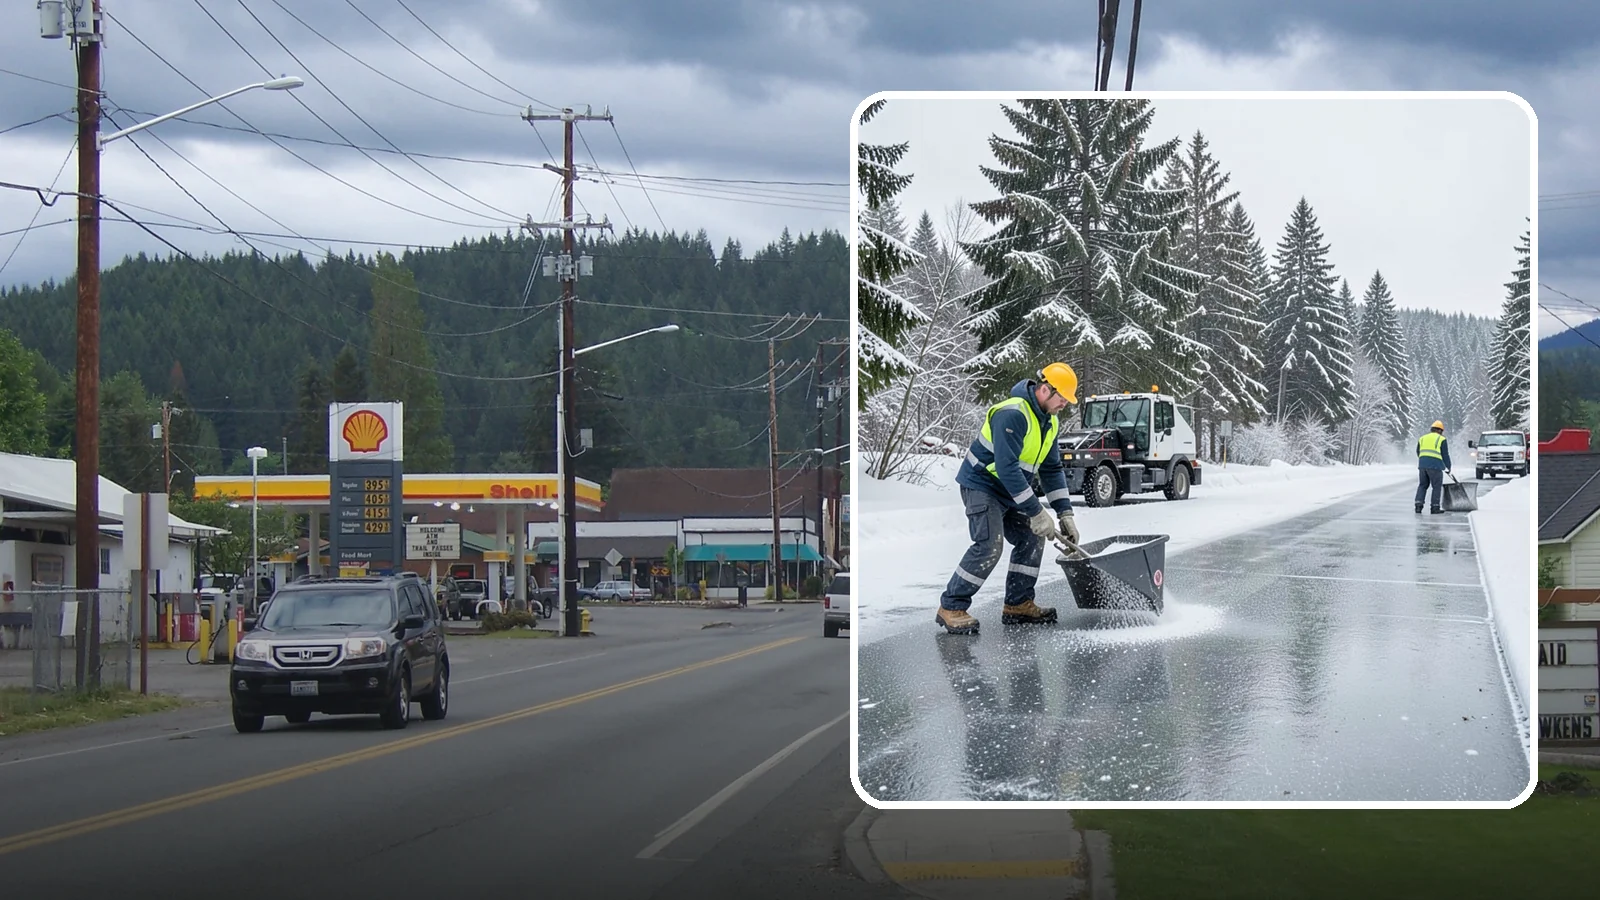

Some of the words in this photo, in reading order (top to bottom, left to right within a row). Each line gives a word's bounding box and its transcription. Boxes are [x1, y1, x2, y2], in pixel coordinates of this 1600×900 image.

[365, 480, 383, 490] 395
[490, 484, 547, 499] Shell
[365, 494, 383, 504] 405
[365, 508, 383, 518] 415
[365, 522, 383, 532] 429
